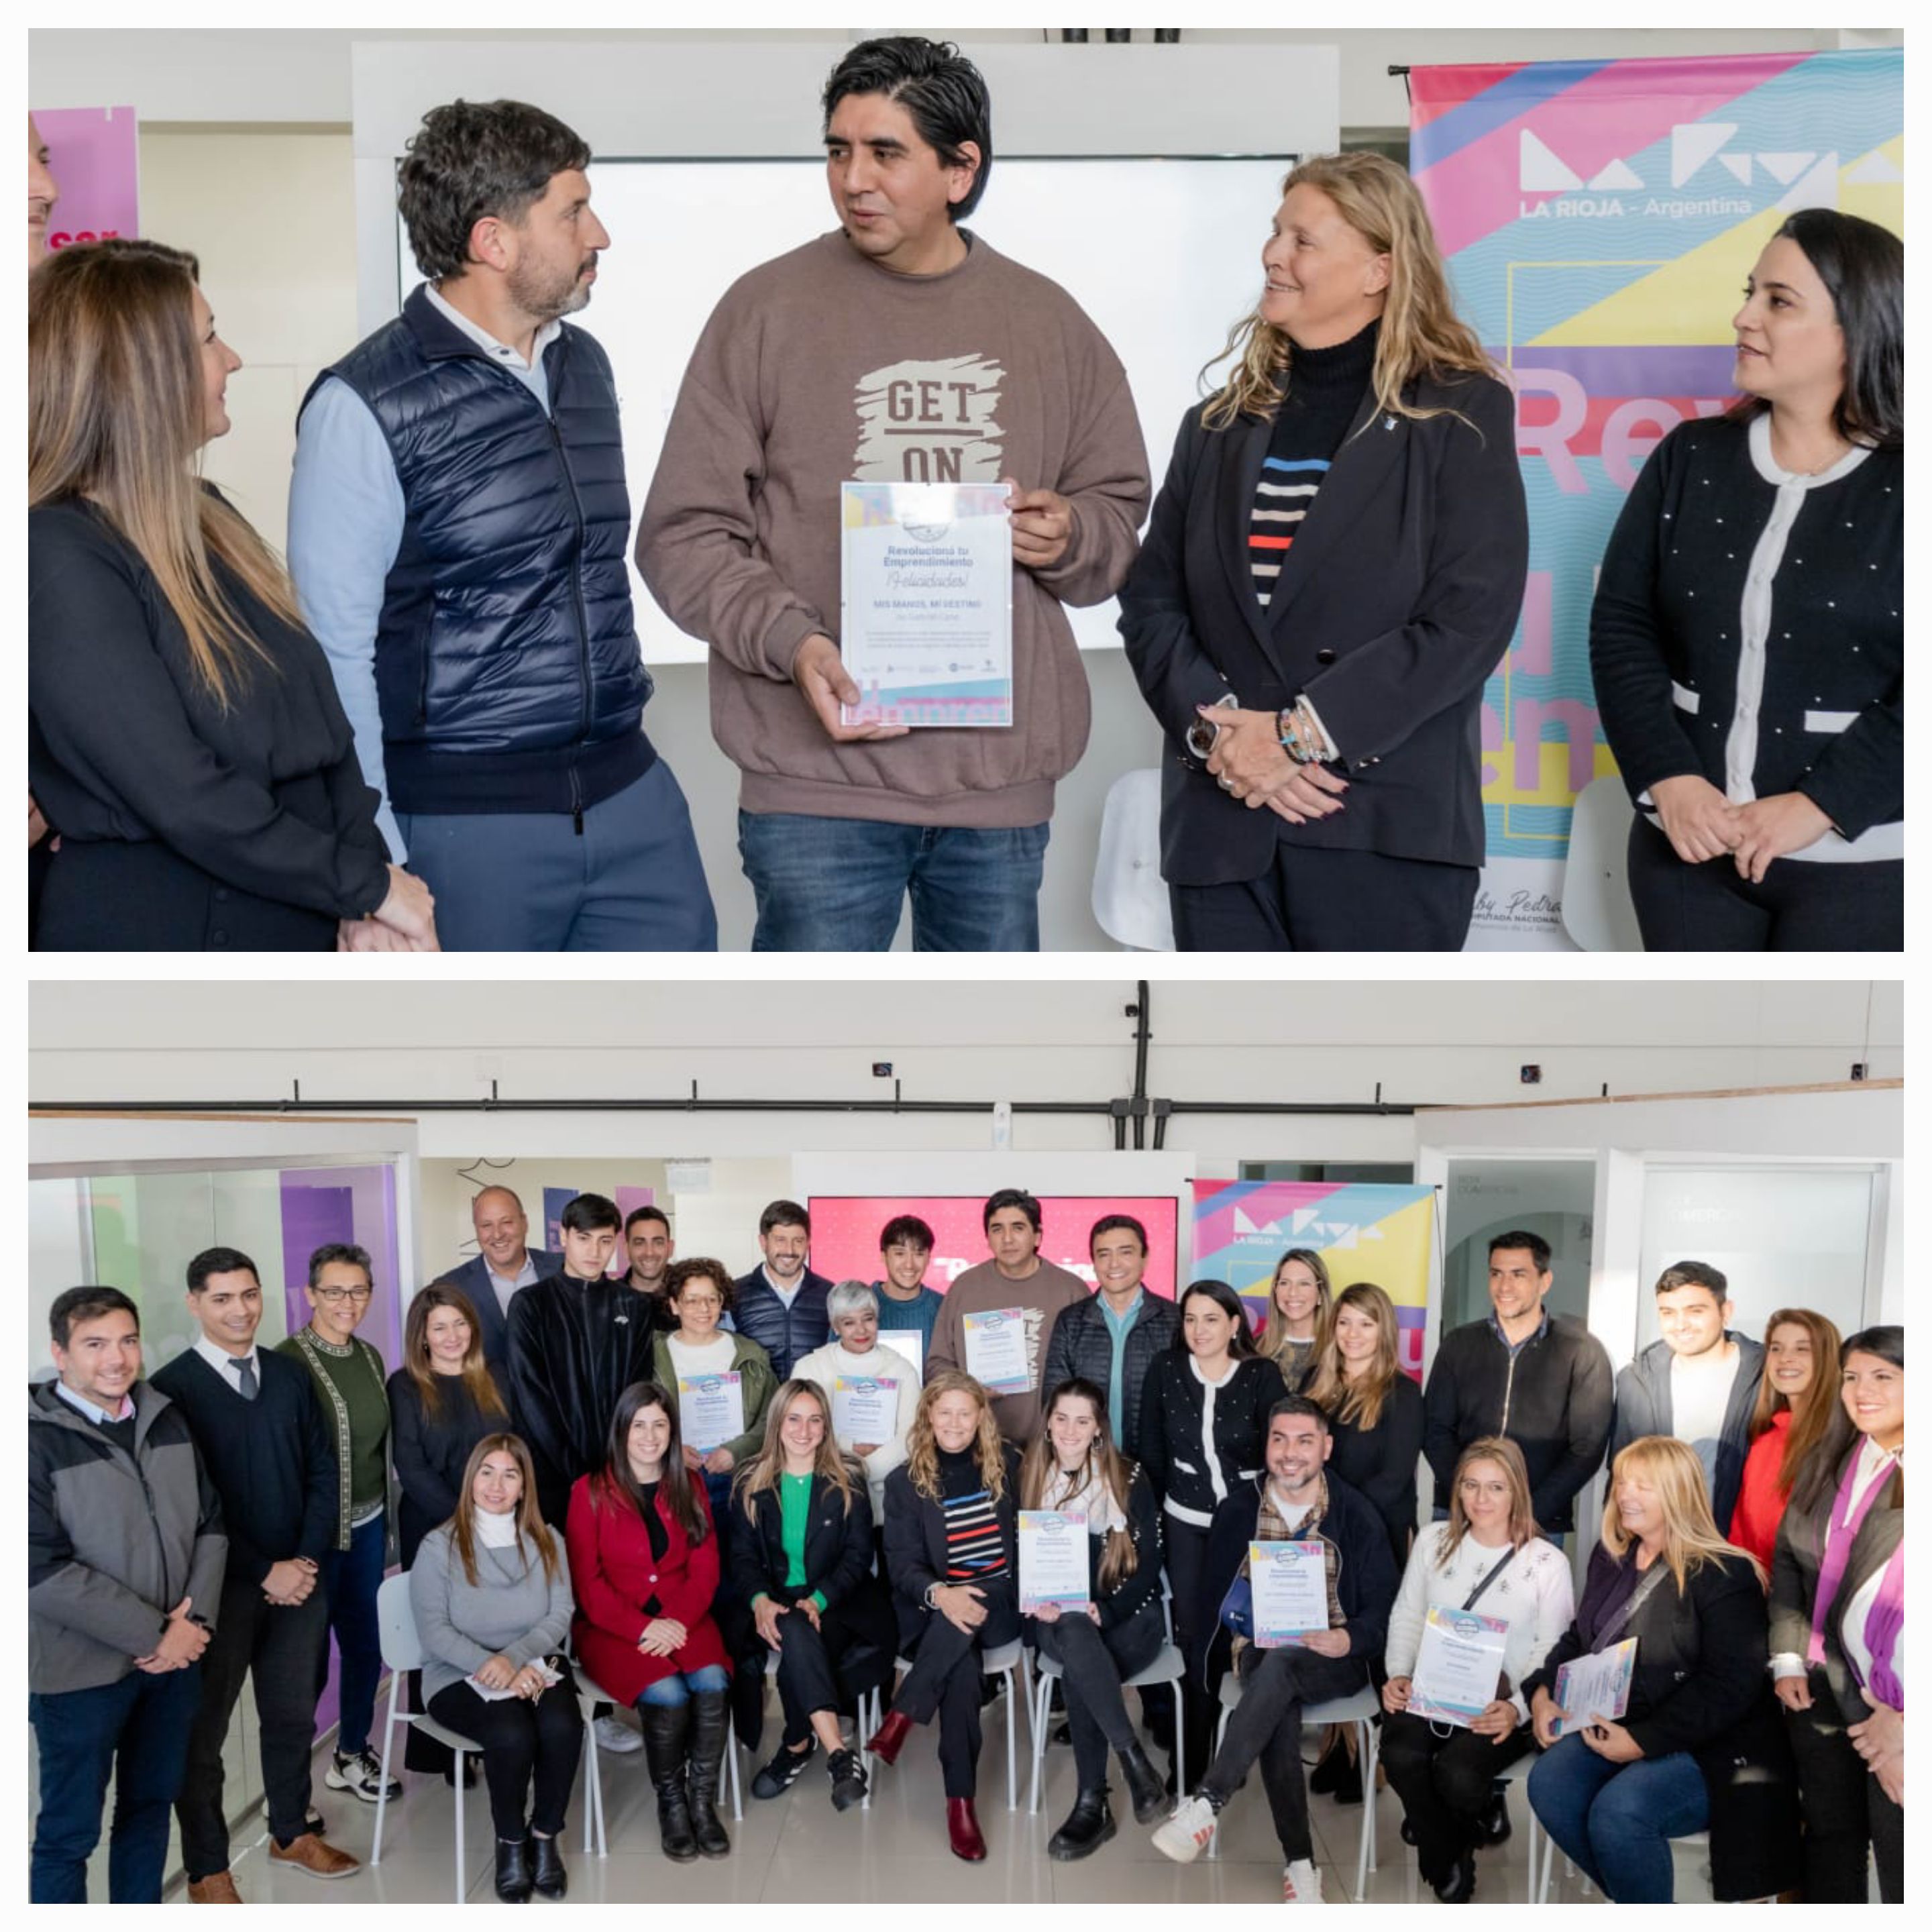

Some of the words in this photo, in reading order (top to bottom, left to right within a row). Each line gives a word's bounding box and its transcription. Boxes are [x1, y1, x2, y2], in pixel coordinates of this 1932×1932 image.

[1519, 201, 1549, 219] LA
[1556, 199, 1623, 218] RIOJA
[1644, 196, 1753, 218] Argentina
[887, 380, 977, 423] GET
[902, 447, 964, 484] ON
[883, 556, 975, 568] Emprendimiento
[1514, 915, 1560, 924] NACIONAL
